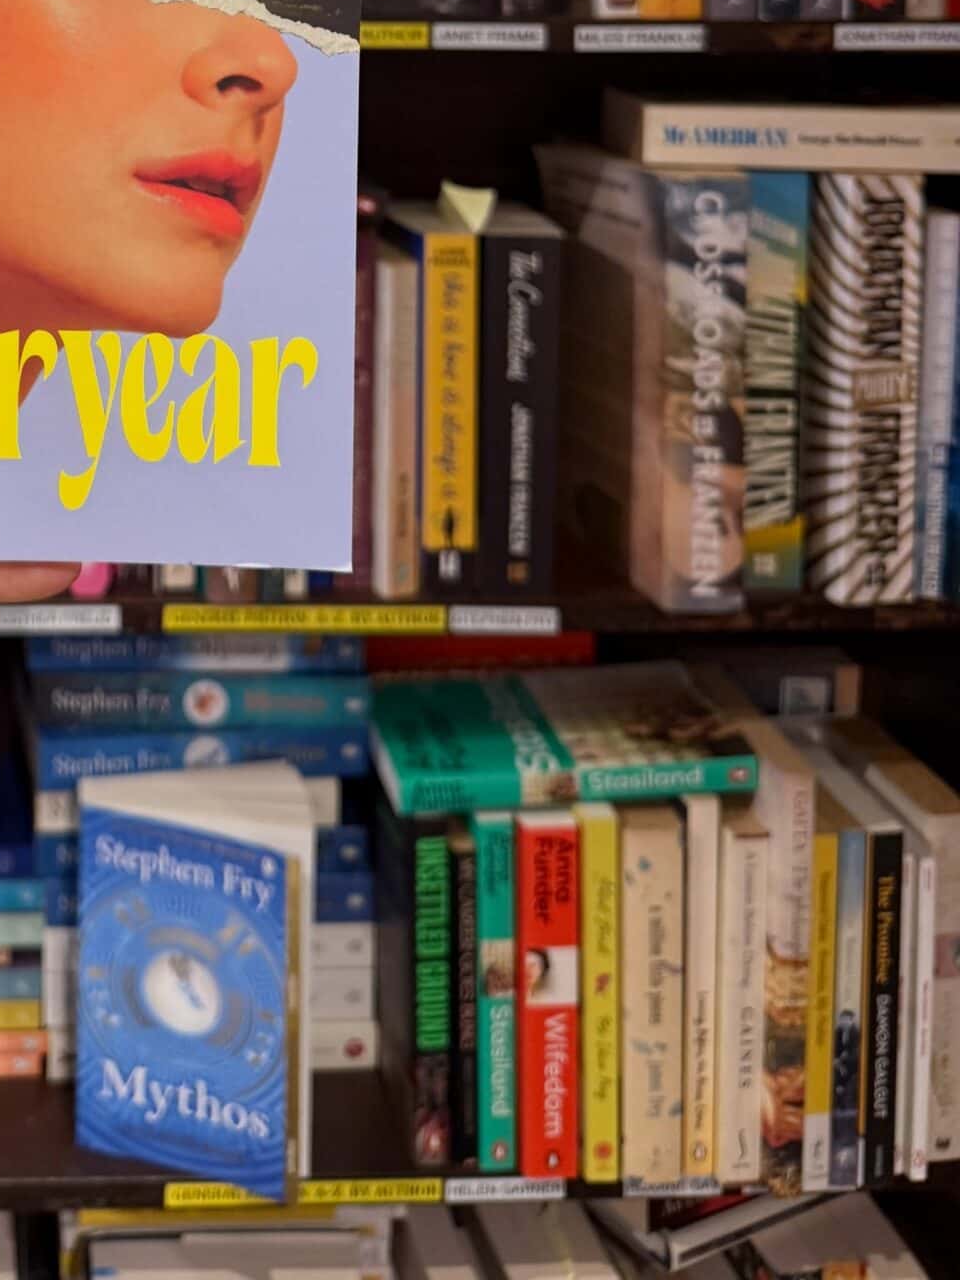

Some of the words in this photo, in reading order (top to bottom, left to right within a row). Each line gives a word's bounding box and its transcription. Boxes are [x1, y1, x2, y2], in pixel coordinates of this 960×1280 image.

[691, 125, 788, 146] AMERICAN
[508, 484, 530, 556] FRANZEN
[691, 446, 725, 597] FRANZEN
[51, 688, 129, 713] Stephen
[136, 689, 170, 713] Fry
[52, 747, 130, 776] Stephen
[588, 765, 705, 794] Stasiland
[95, 835, 216, 888] Stephen
[222, 860, 276, 912] Fry
[416, 836, 450, 957] UNSETTLED
[533, 835, 555, 924] Funder
[554, 836, 574, 904] Anna
[876, 875, 895, 911] The
[416, 959, 450, 1050] GROUND
[872, 994, 889, 1056] DAMON
[489, 1006, 512, 1119] Stasiland
[543, 1012, 569, 1139] Wifedom
[871, 1059, 888, 1119] GALGUT
[100, 1060, 270, 1139] Mythos
